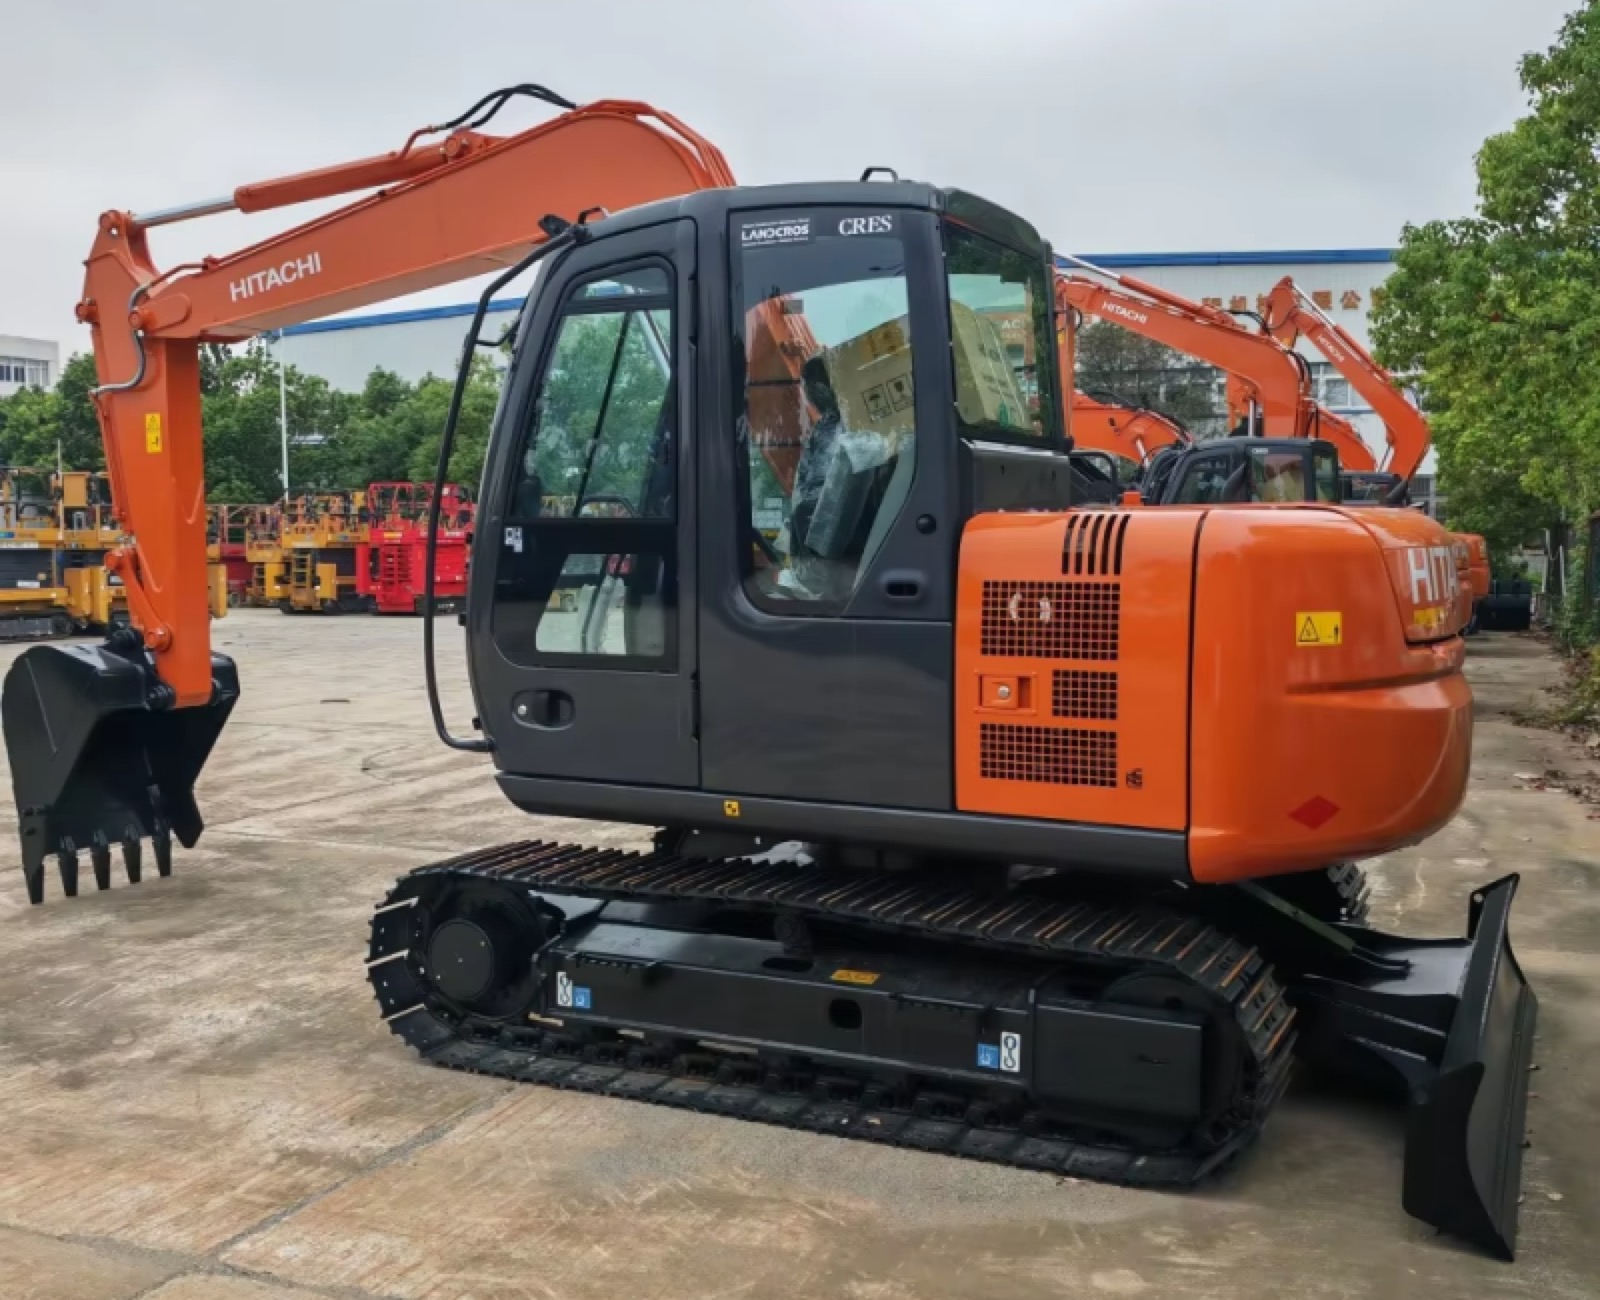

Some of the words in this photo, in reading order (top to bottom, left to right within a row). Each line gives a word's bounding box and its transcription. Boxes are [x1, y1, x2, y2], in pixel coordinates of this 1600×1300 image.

[741, 224, 809, 241] LANDCROS
[838, 214, 893, 236] CRES
[229, 251, 322, 303] HITACHI
[1101, 300, 1149, 324] HITACHI
